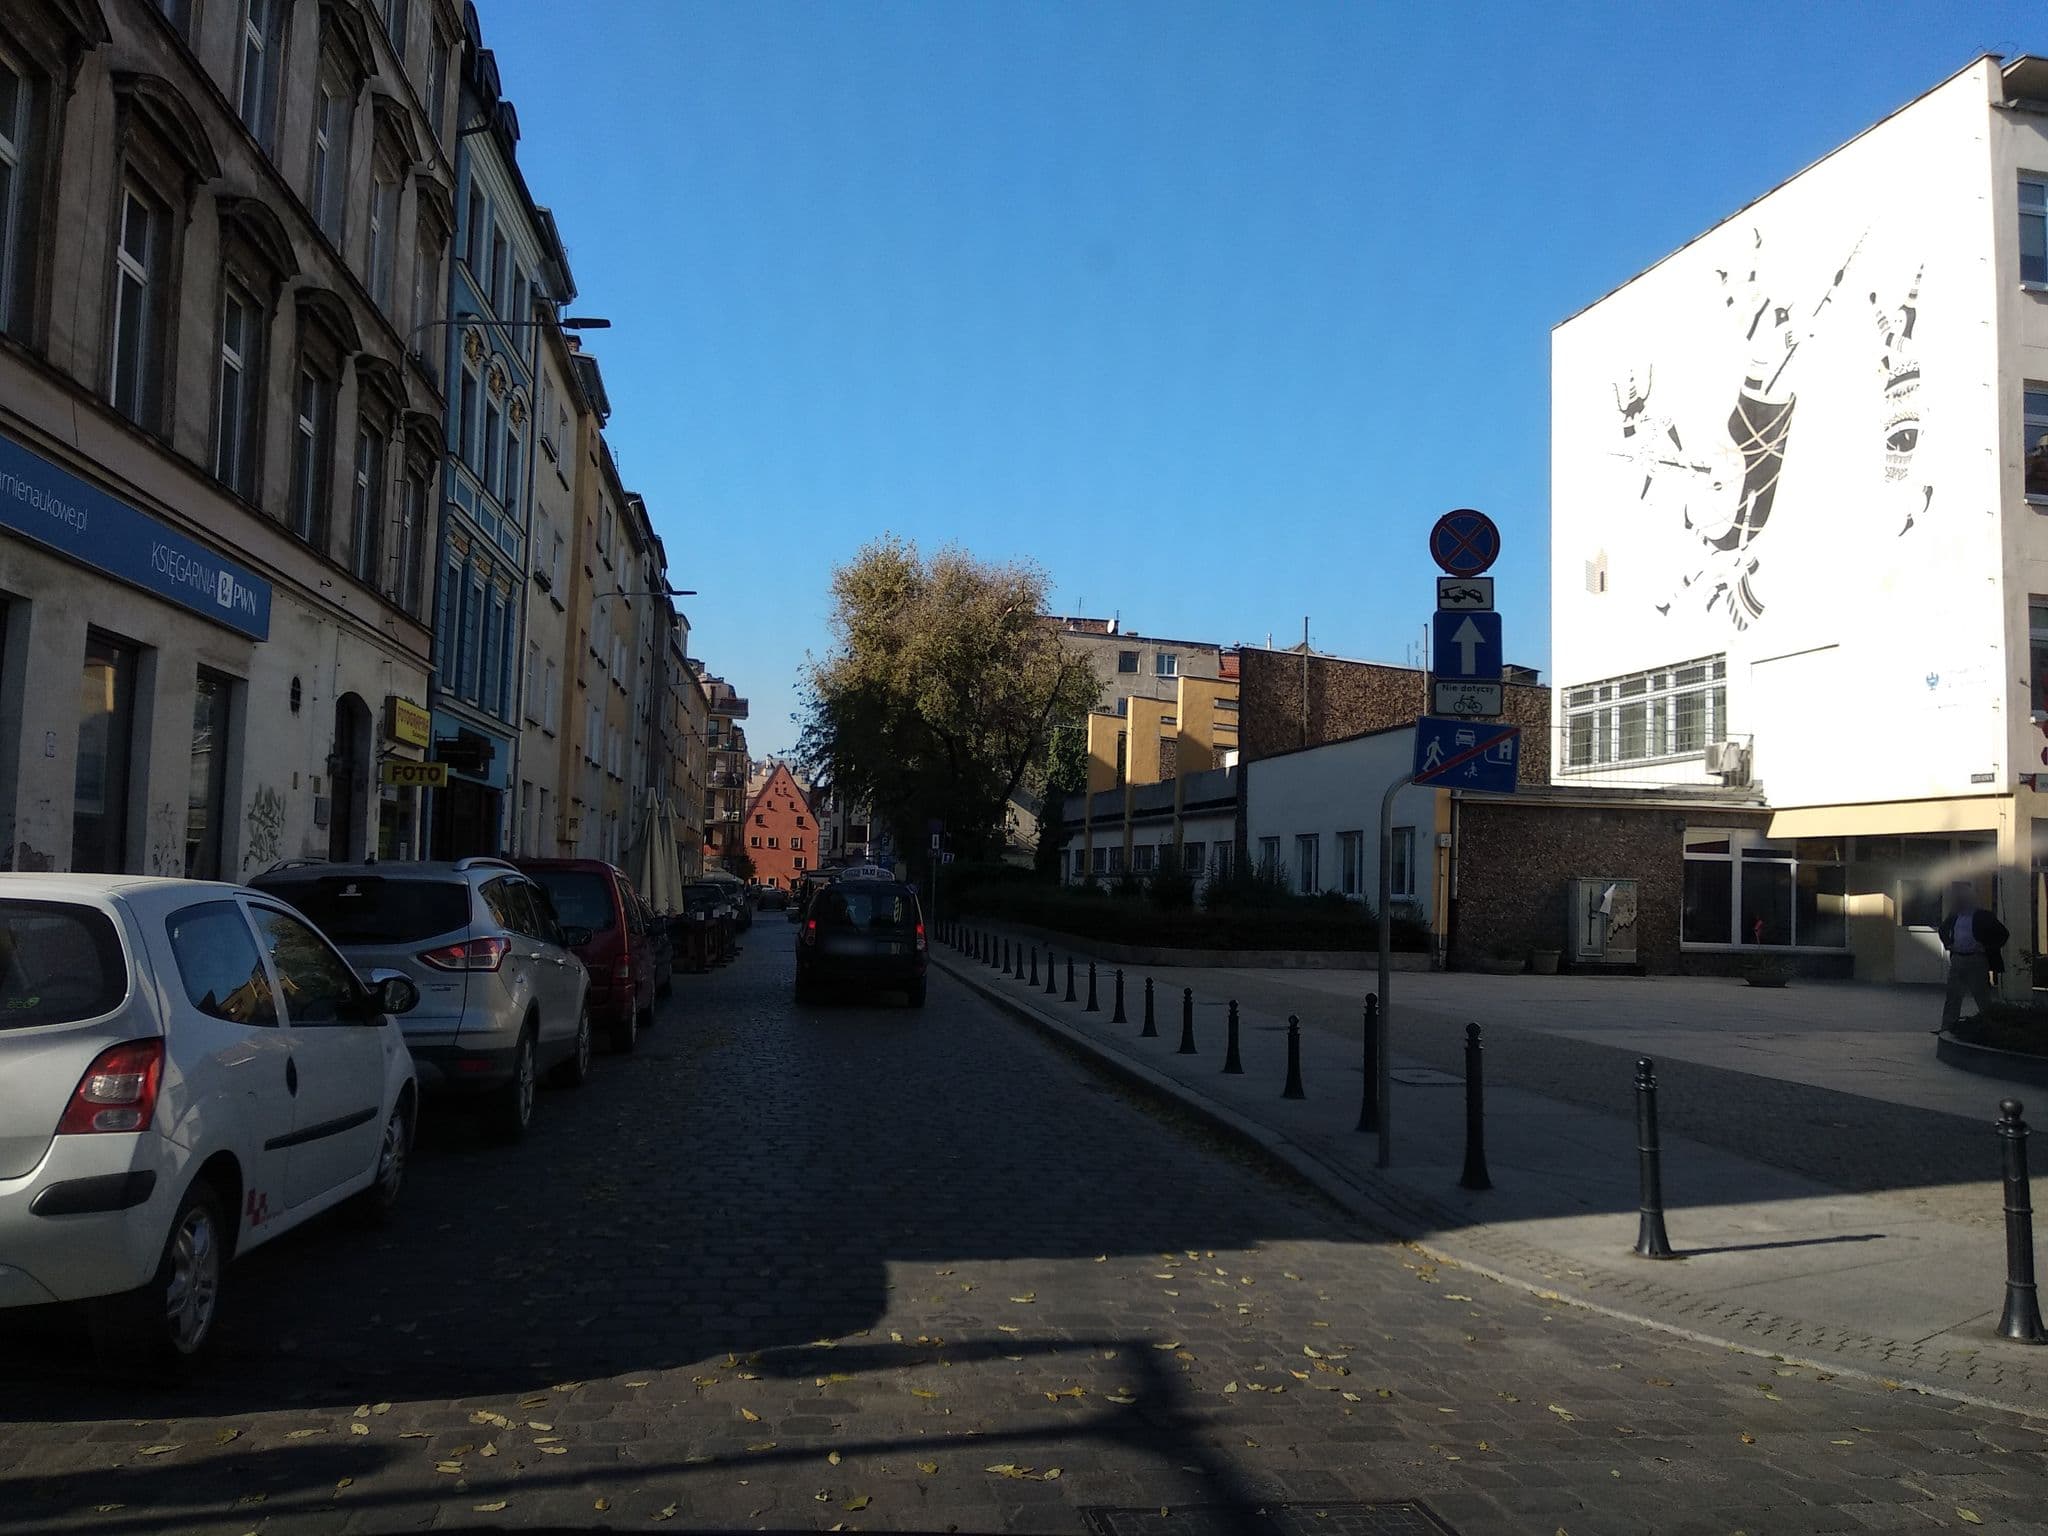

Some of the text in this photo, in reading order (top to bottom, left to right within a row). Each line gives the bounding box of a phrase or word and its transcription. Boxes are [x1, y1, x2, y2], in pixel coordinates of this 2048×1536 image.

[0, 472, 89, 533] rnienaukowe.pl
[151, 541, 257, 616] KSIĘGARNIA PWN
[391, 765, 441, 782] FOTO
[862, 868, 876, 876] TAXI
